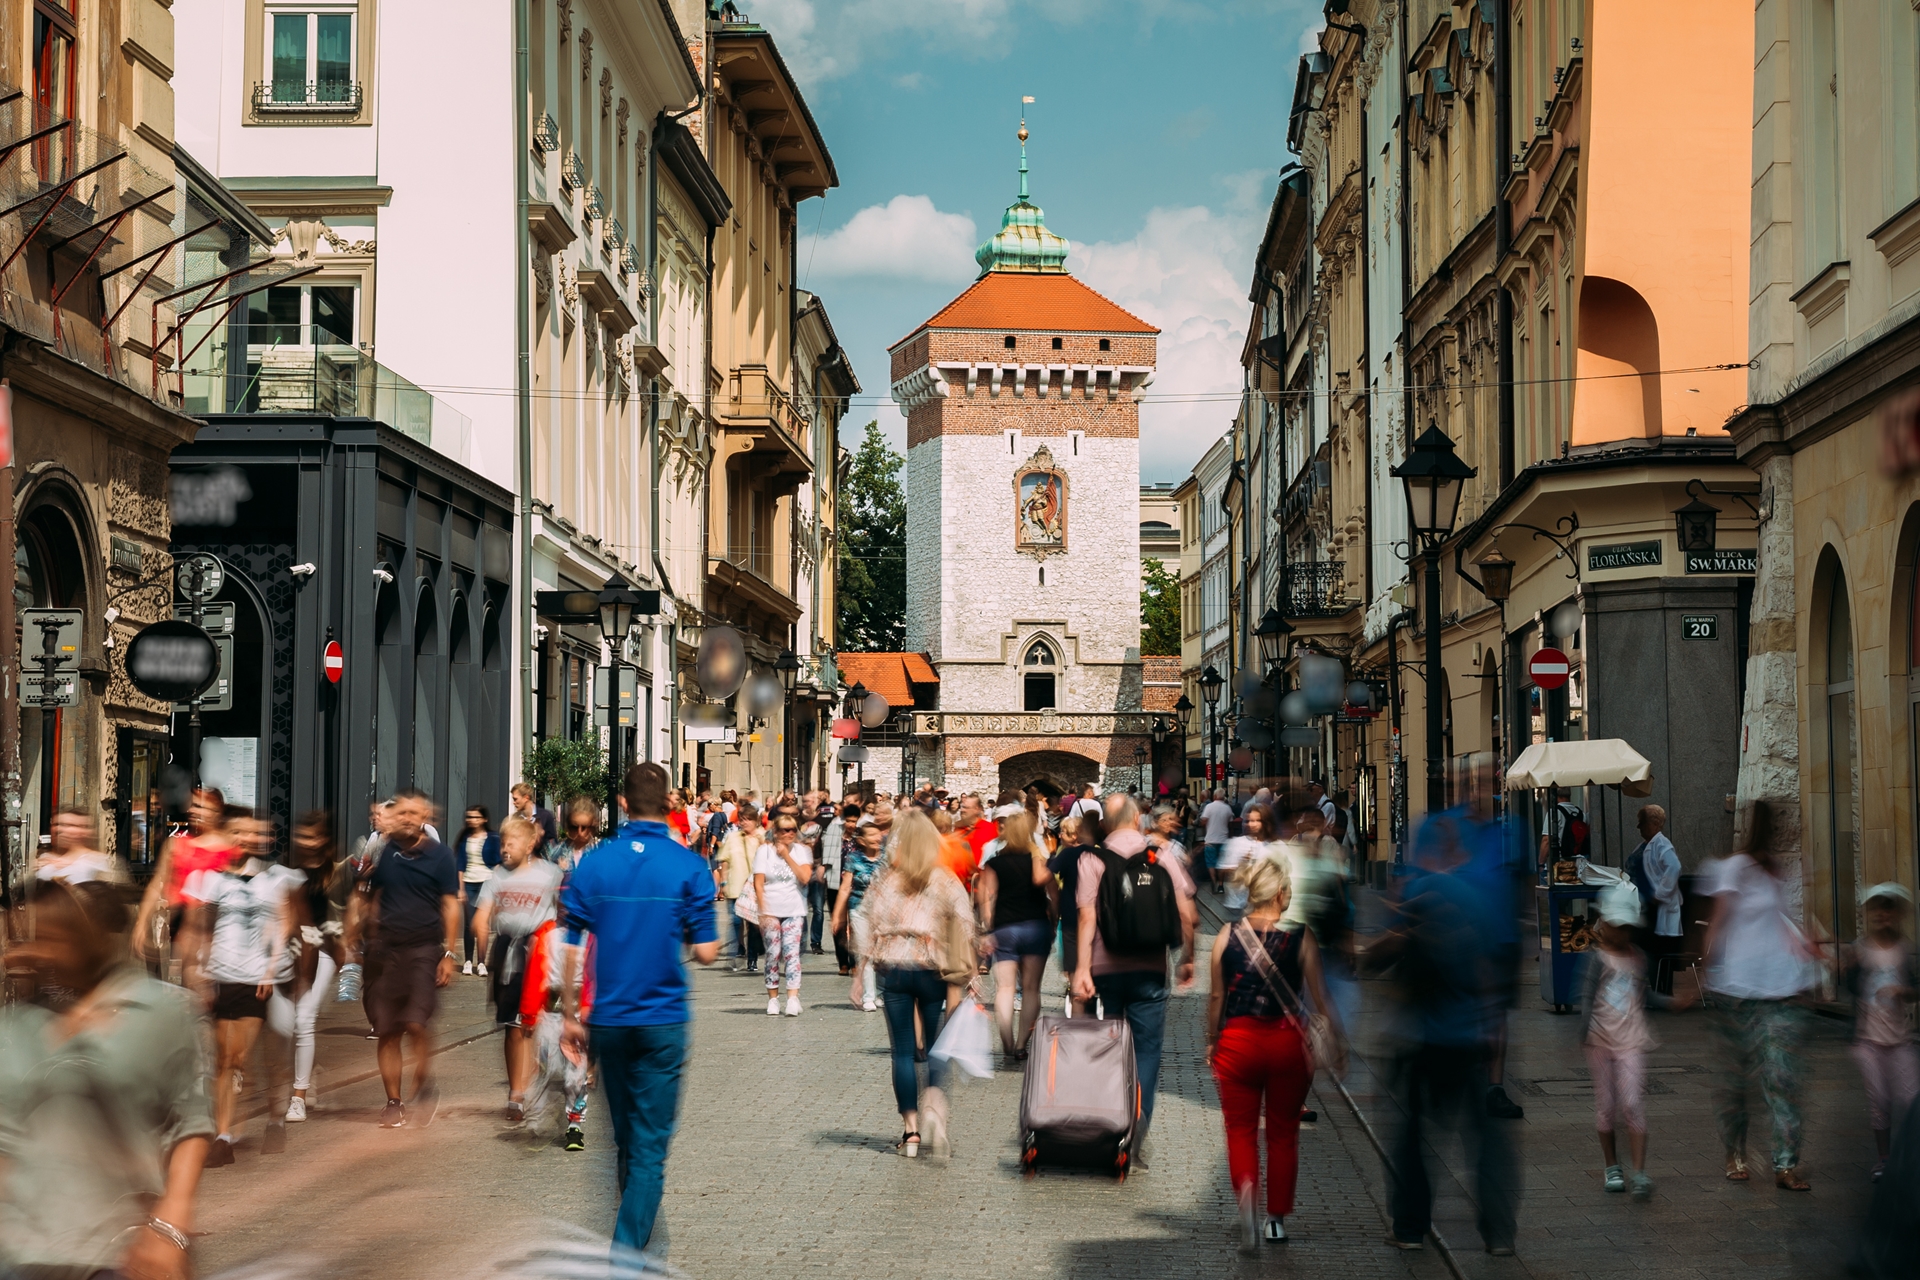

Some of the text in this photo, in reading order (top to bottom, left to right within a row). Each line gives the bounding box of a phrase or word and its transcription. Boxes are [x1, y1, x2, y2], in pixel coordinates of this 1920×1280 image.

[1590, 551, 1658, 568] FLORIAŃSKA
[1690, 558, 1757, 571] ŚW. MARK
[1691, 623, 1710, 636] 20
